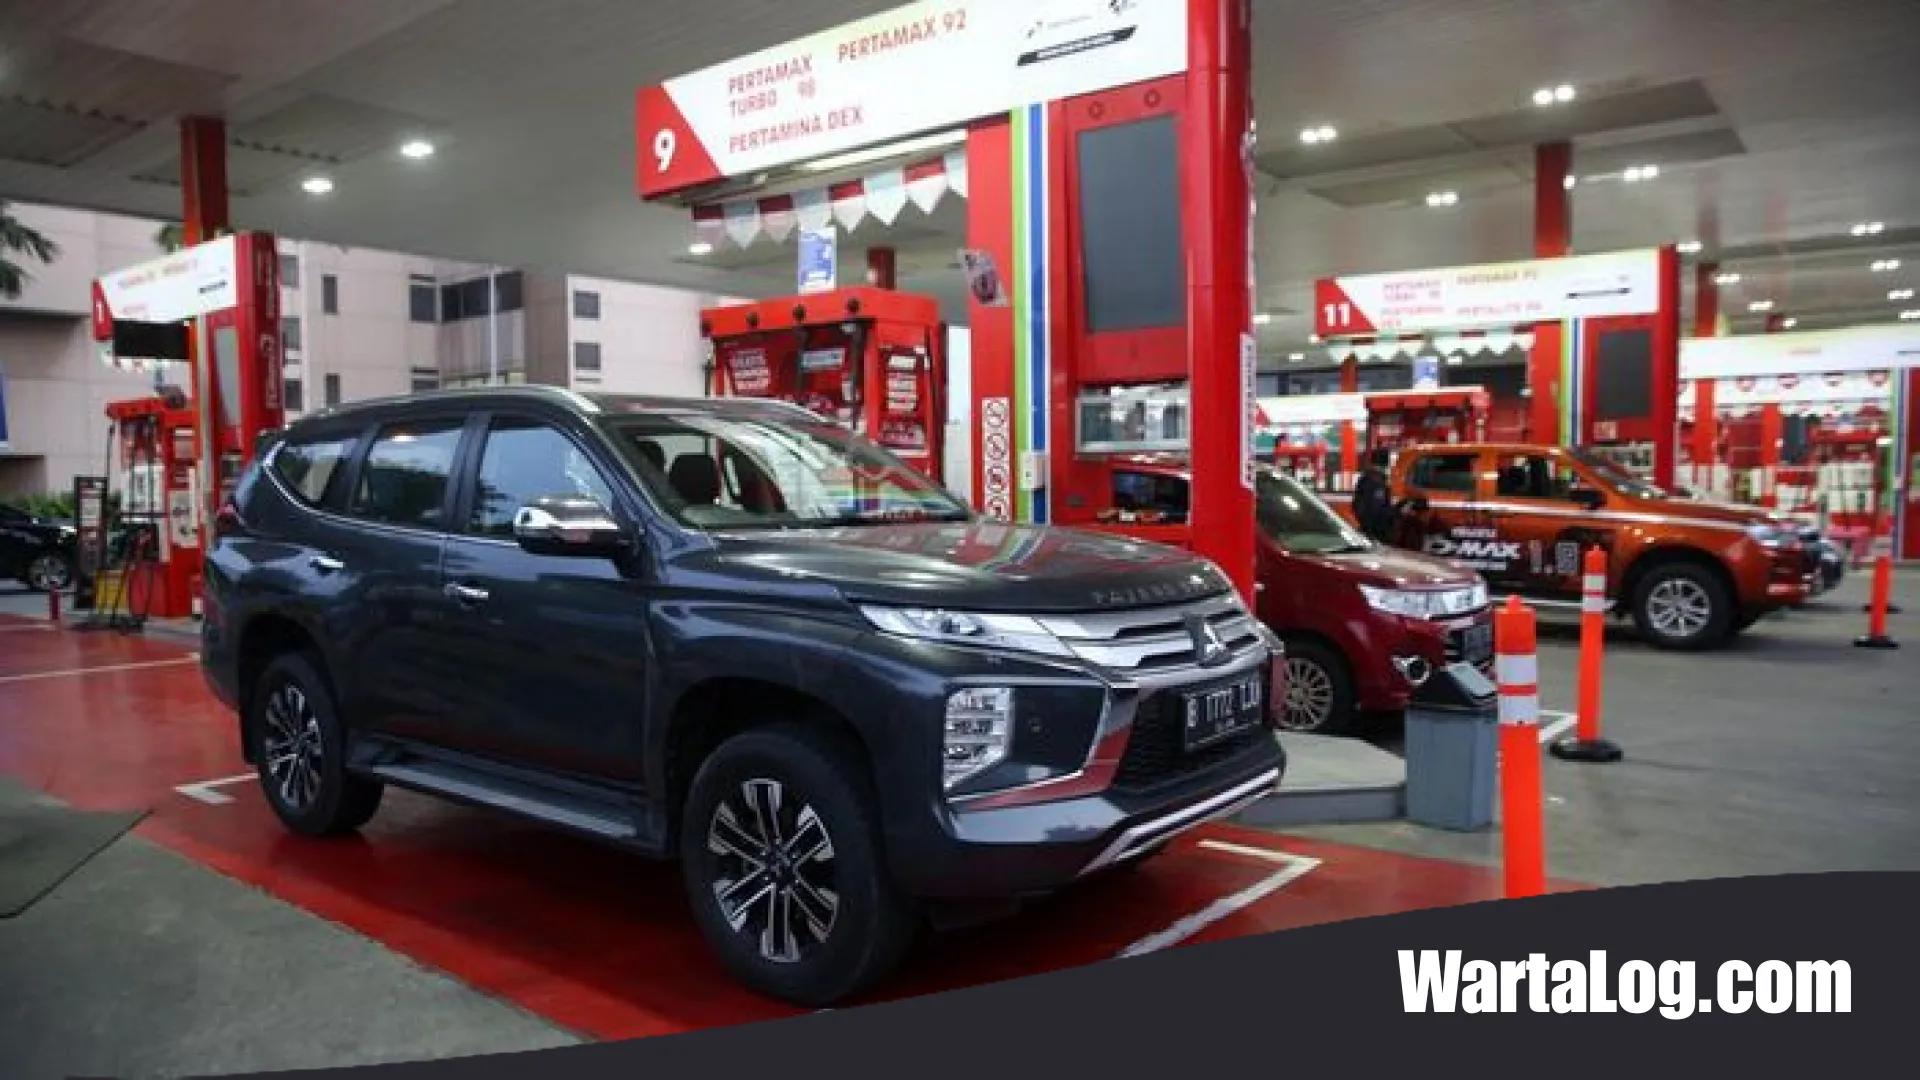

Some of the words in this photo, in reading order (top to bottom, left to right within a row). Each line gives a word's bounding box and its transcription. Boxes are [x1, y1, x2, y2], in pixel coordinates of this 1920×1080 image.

[837, 15, 936, 63] PERTAMAX
[943, 8, 966, 32] 92
[728, 54, 813, 94] PERTAMAX
[729, 89, 777, 118] TURBO
[729, 115, 823, 154] PERTAMINA
[828, 105, 865, 130] DEX
[652, 129, 676, 171] 9
[1324, 303, 1351, 327] 11
[1186, 698, 1197, 728] B
